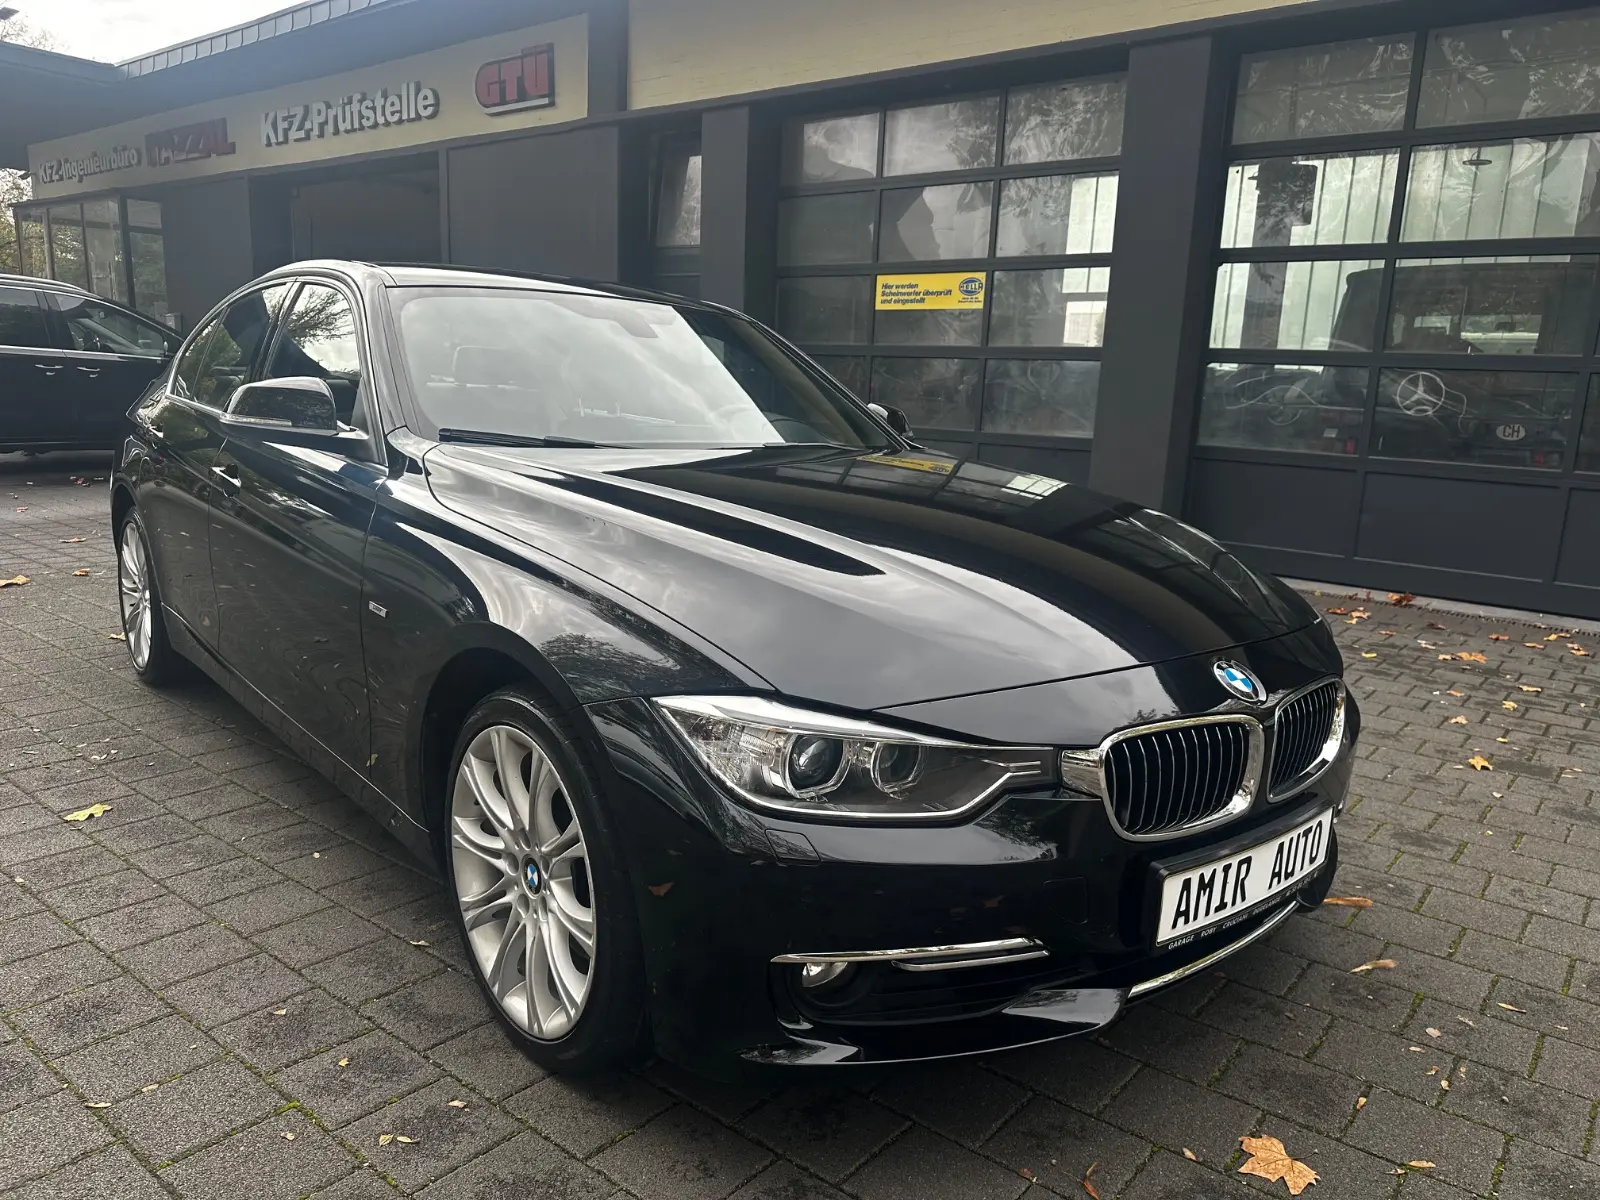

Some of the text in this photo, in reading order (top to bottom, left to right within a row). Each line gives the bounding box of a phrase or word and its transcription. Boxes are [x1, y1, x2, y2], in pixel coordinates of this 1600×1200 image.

[475, 43, 551, 108] GTÜ
[260, 81, 439, 146] KFZ-Prüfstelle
[39, 144, 141, 184] KFZ-Ingenieurbüro
[893, 297, 926, 306] eingestellt
[922, 289, 952, 298] überprüft
[1502, 424, 1521, 439] CH
[1171, 819, 1323, 930] AMIR AUTO
[1168, 934, 1195, 950] GARAGE
[1200, 926, 1218, 938] ROBY
